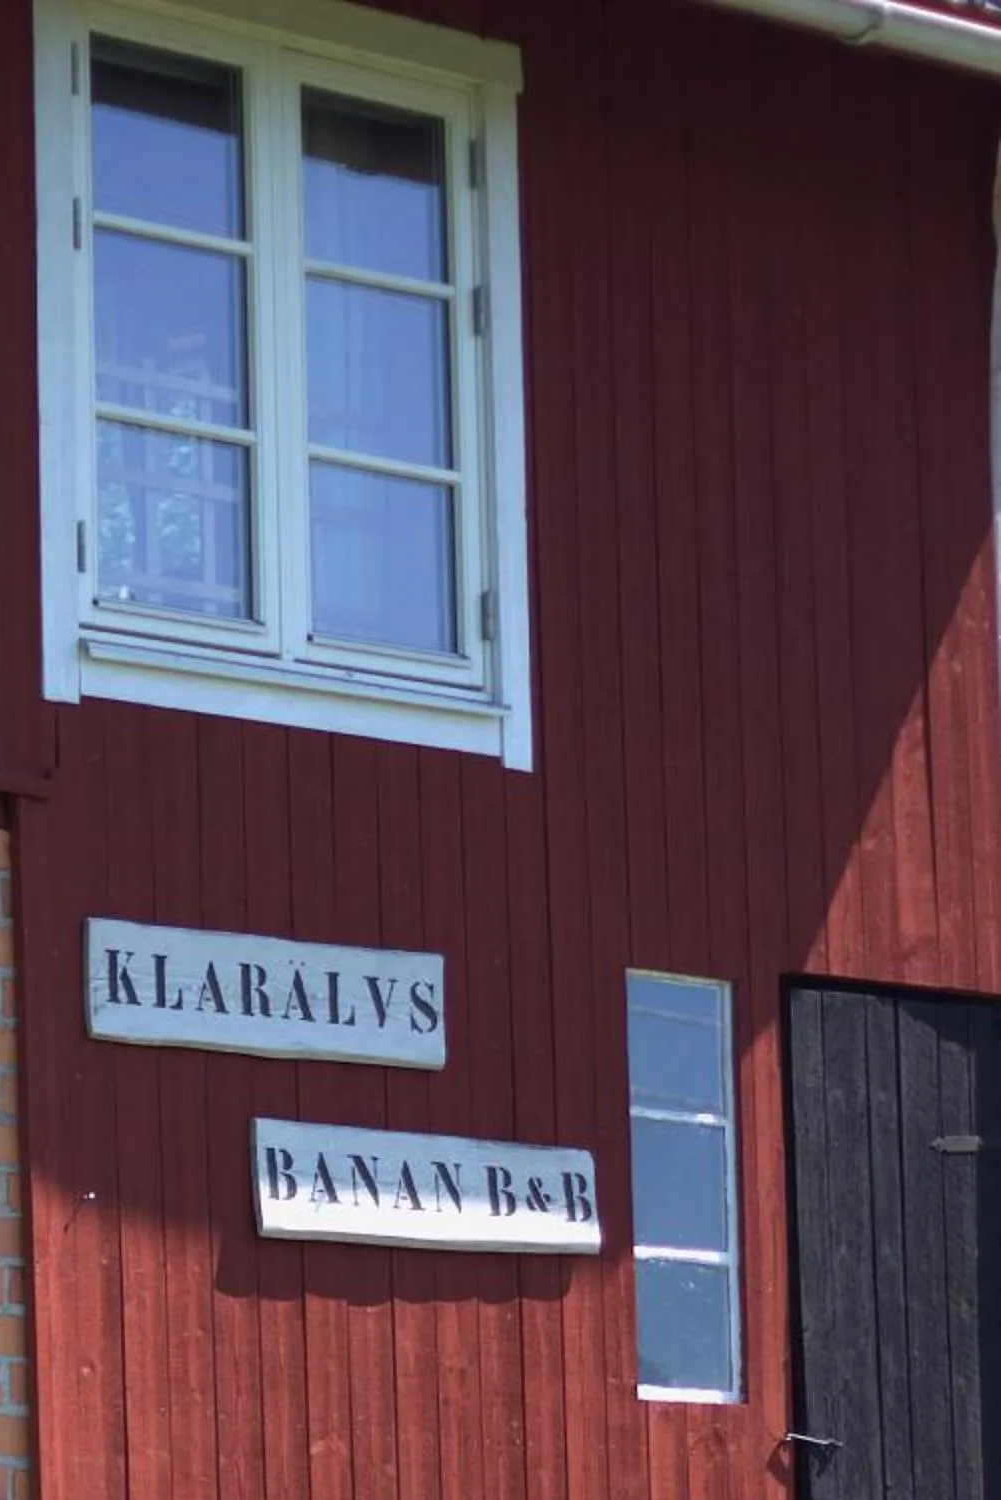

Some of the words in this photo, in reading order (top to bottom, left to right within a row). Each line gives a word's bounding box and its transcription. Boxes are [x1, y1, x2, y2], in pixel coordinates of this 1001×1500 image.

[104, 949, 439, 1034] KLARÄLVS
[264, 1147, 463, 1214] BANAN
[484, 1165, 593, 1223] B&B
